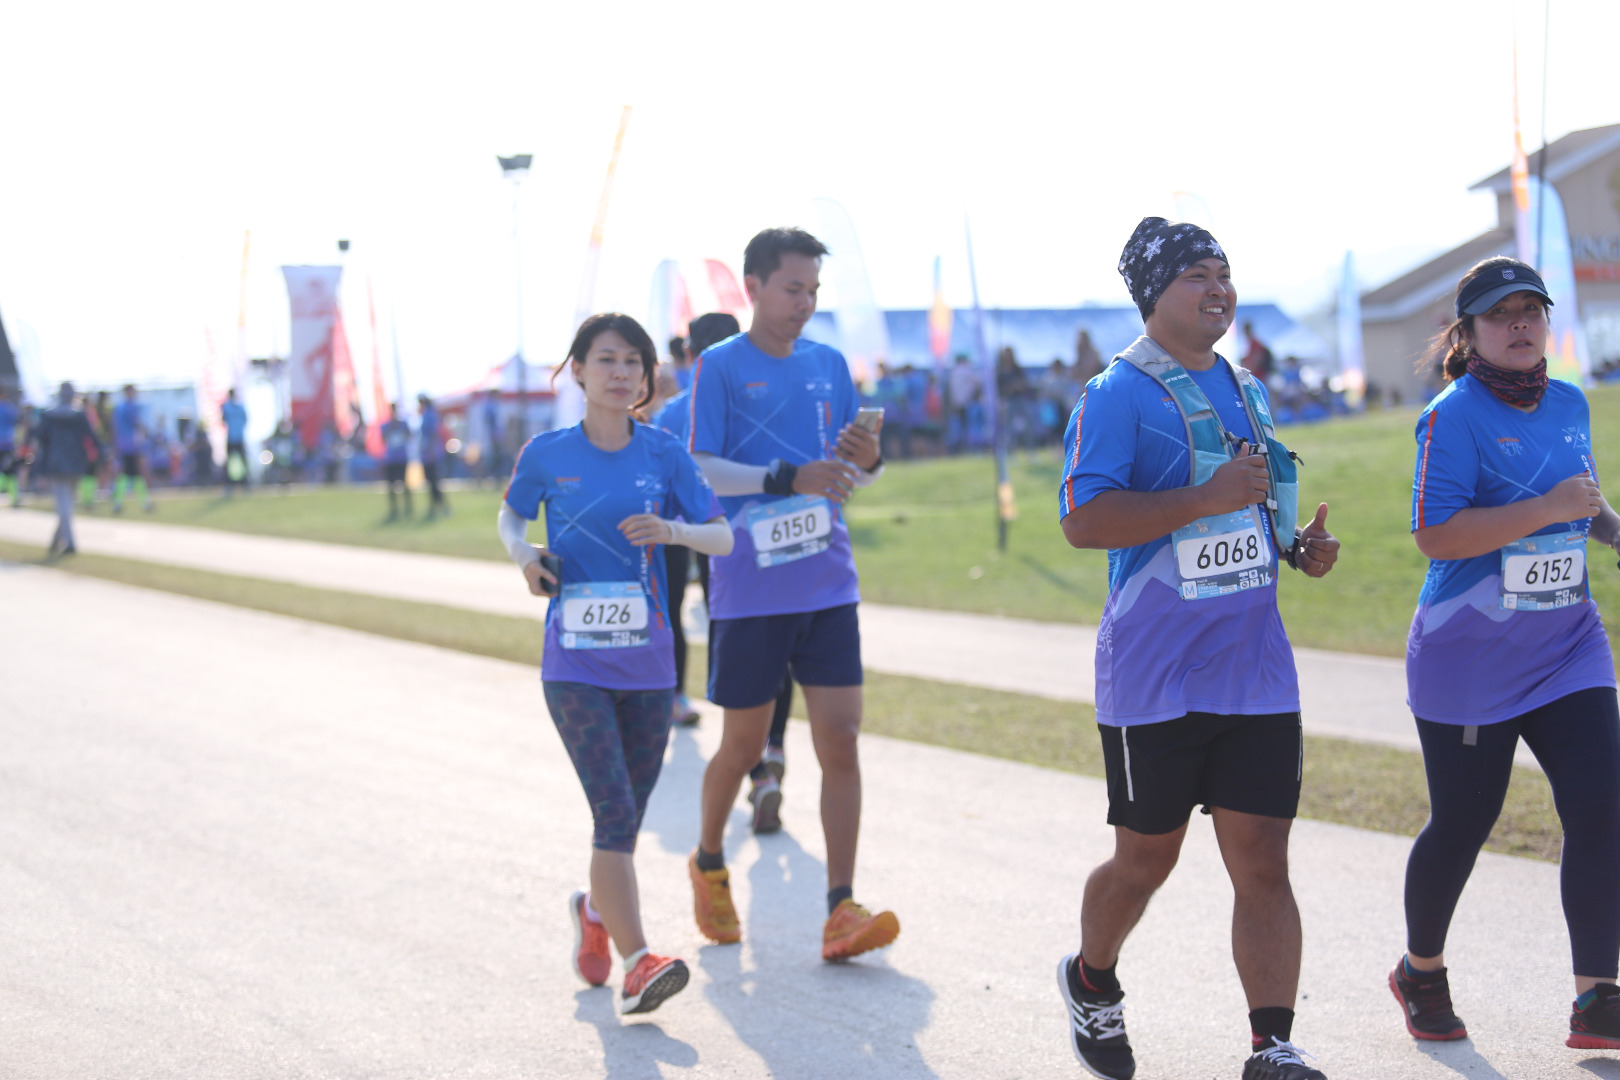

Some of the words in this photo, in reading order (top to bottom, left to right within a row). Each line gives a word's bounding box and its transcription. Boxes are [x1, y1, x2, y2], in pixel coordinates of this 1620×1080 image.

[771, 513, 816, 543] 6150
[1261, 512, 1270, 535] RUN
[1197, 534, 1258, 570] 6068
[1525, 557, 1572, 585] 6152
[1185, 586, 1195, 596] M
[1506, 597, 1514, 607] F
[582, 603, 631, 625] 6126
